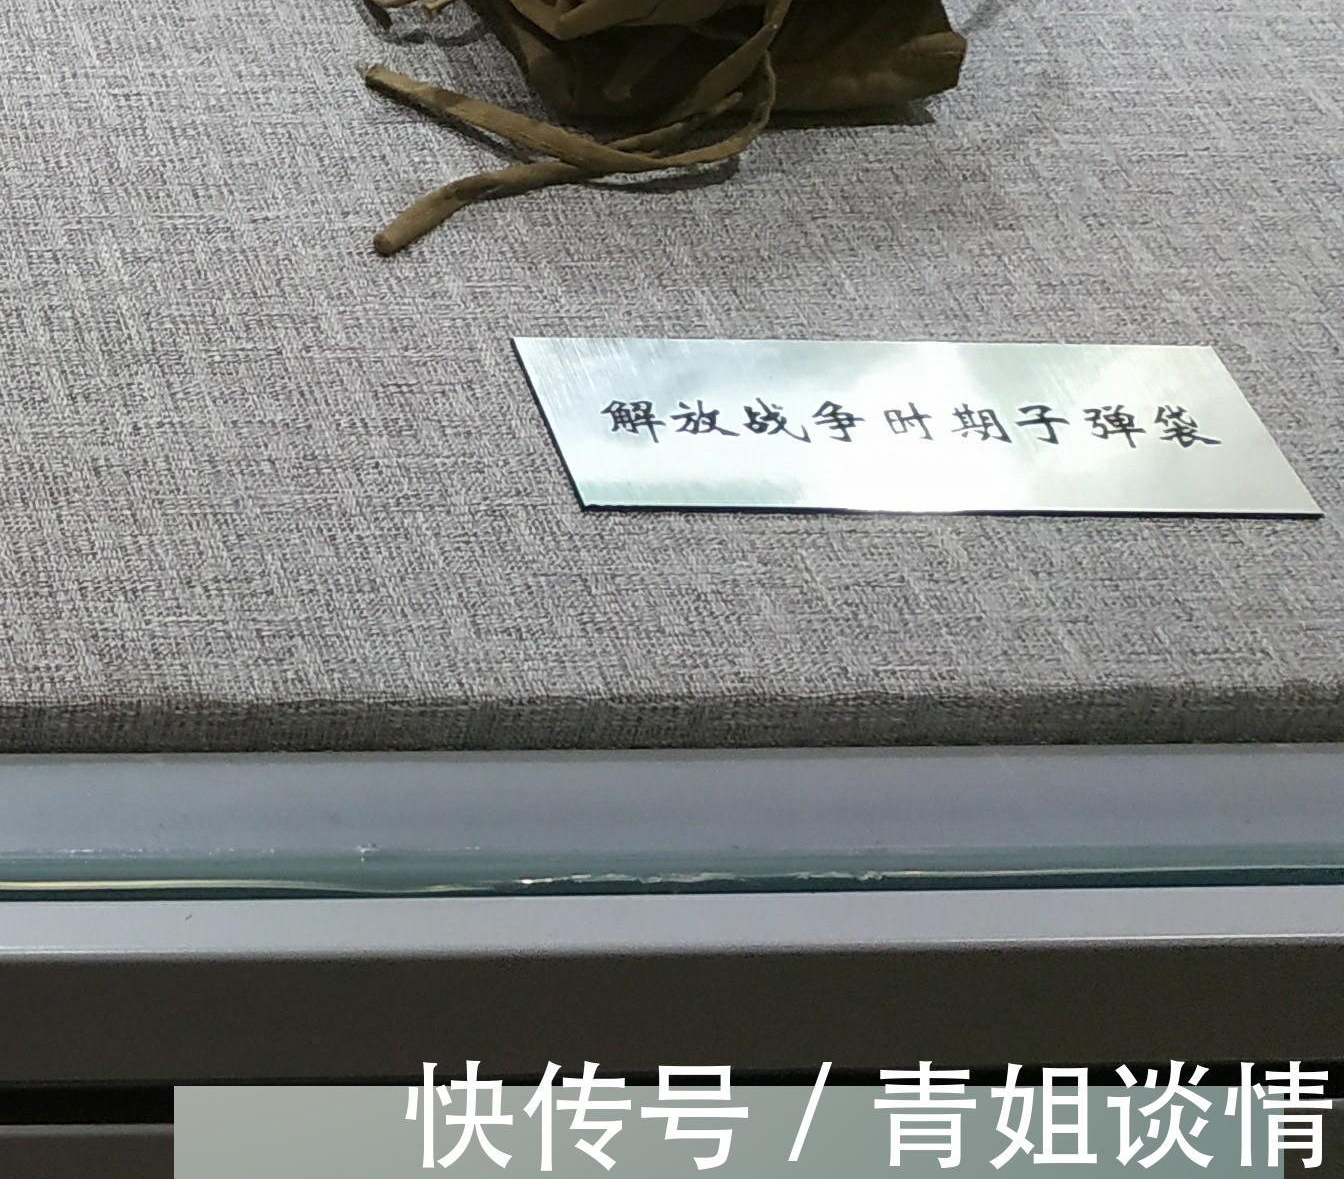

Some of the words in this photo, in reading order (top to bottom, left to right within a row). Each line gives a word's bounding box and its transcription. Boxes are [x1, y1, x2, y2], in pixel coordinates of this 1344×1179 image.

[600, 399, 1222, 448] 解放战争时期子弹袋
